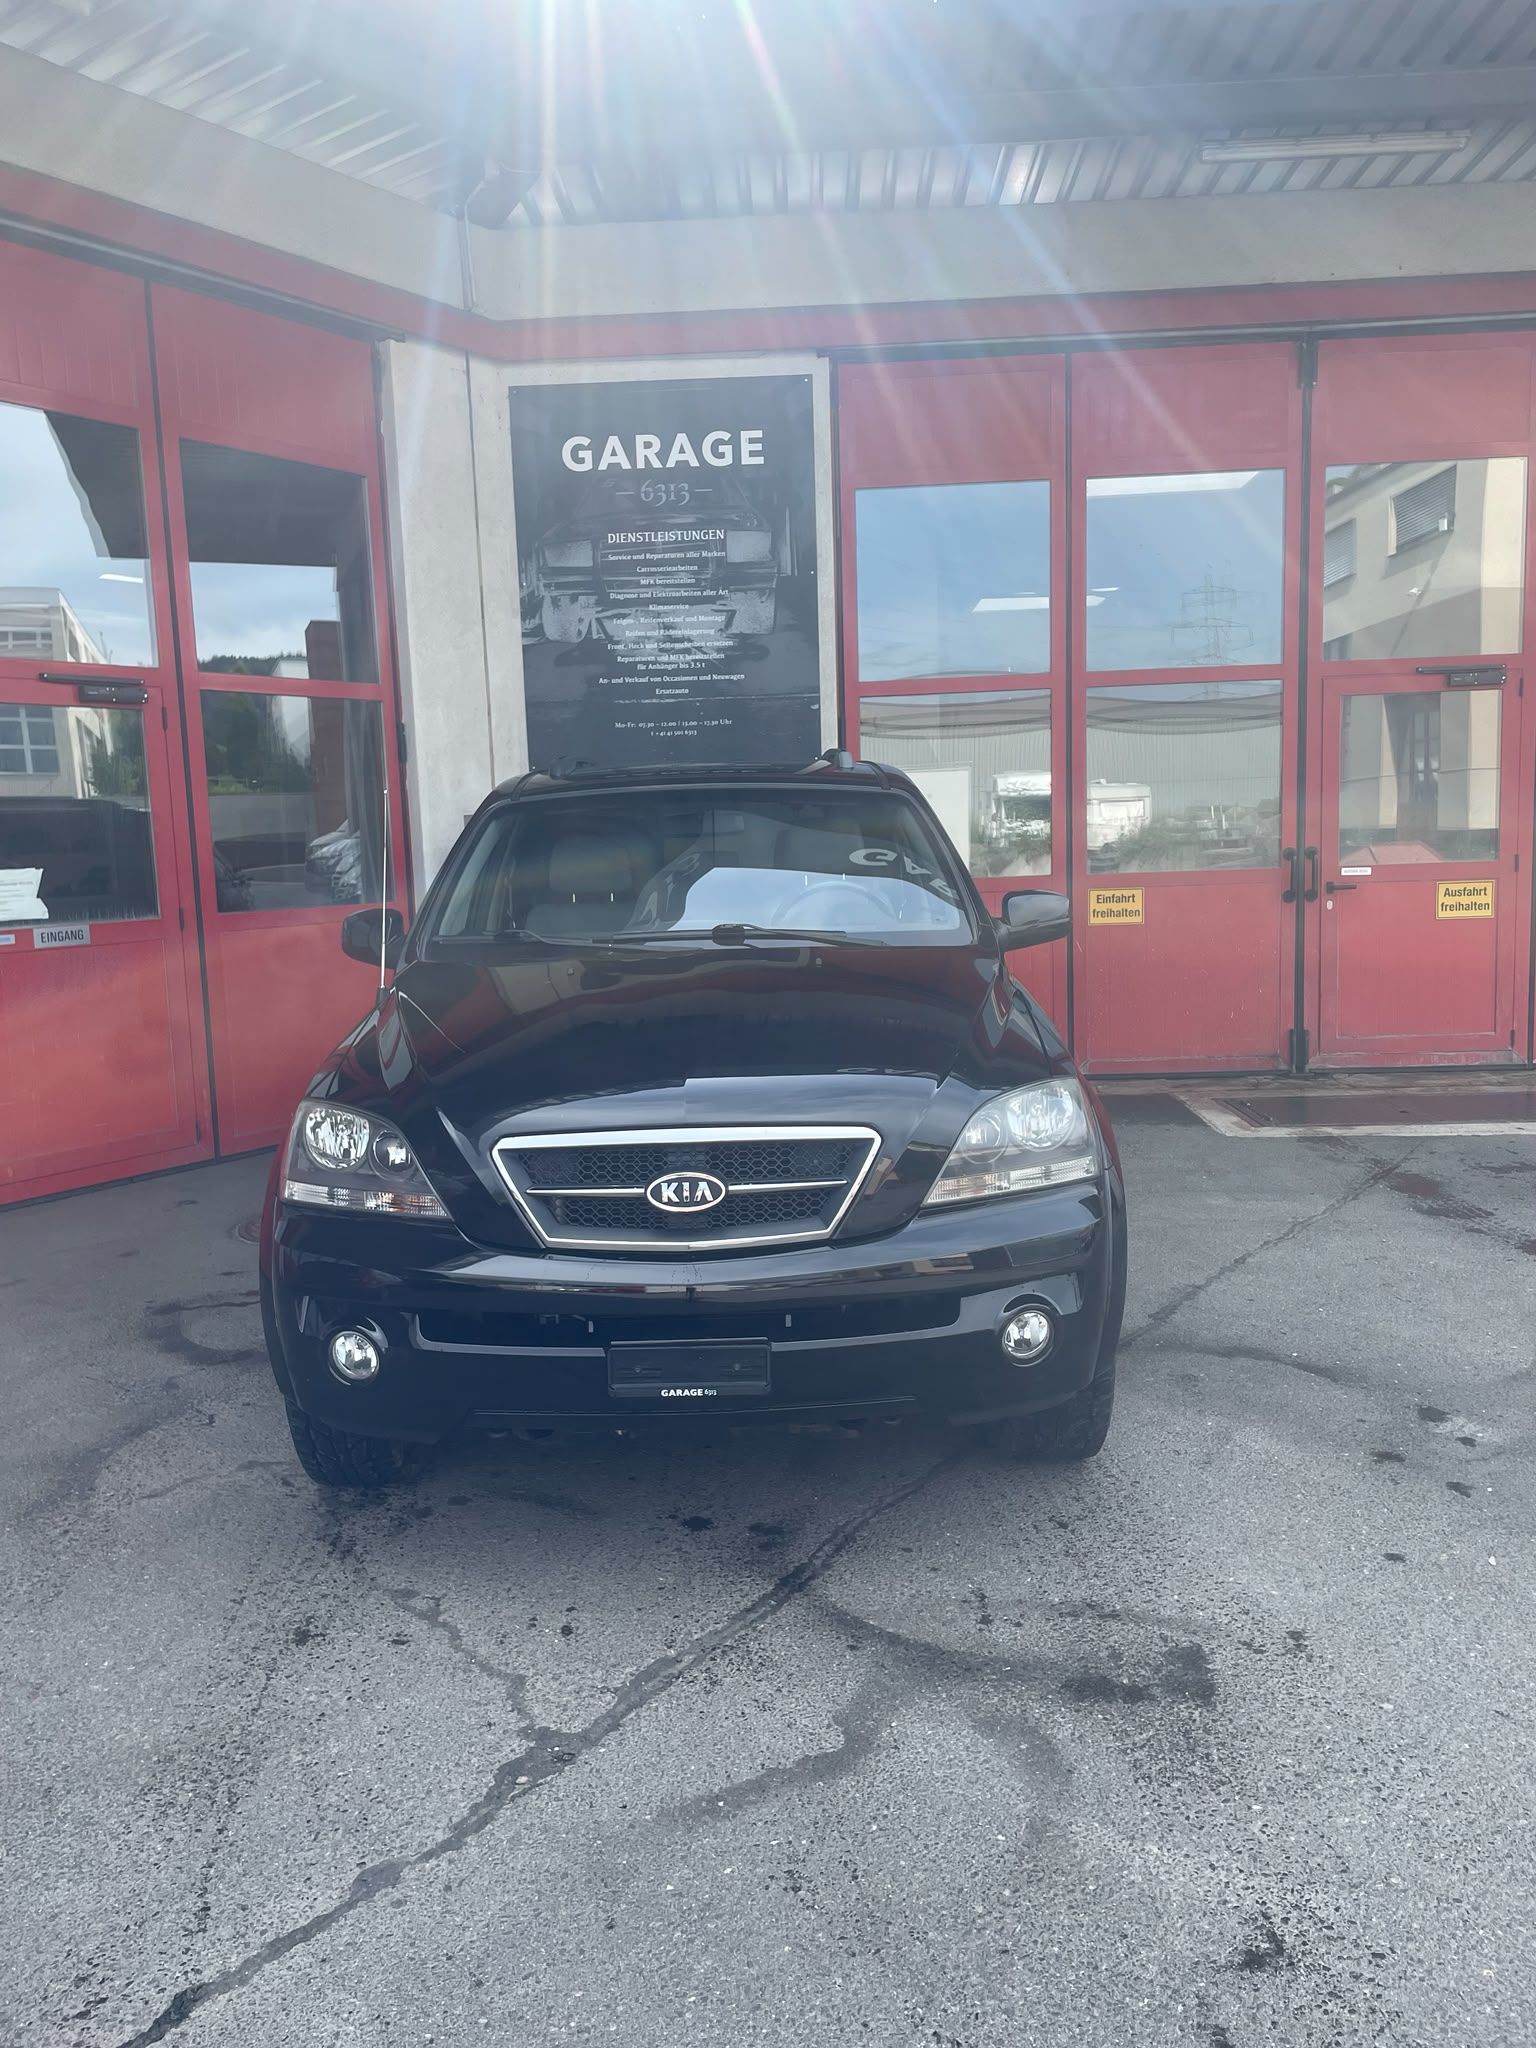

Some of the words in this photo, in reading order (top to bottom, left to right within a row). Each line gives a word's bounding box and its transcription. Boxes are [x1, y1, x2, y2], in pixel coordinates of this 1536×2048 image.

[561, 429, 765, 472] GARAGE
[640, 478, 691, 507] 6313
[607, 529, 725, 544] DIENSTLEISTUNGEN
[646, 552, 685, 561] Reparaturen
[686, 551, 700, 559] aller
[640, 578, 655, 586] MFK
[656, 577, 696, 585] bereitstellen
[610, 592, 638, 601] Diagnose
[639, 591, 652, 599] und
[653, 590, 701, 599] Elektroarbeiten
[702, 589, 717, 597] aller
[718, 588, 729, 597] Art
[640, 616, 684, 625] Reifenverkauf
[685, 615, 698, 623] und
[699, 614, 726, 623] Montage
[625, 630, 646, 638] Reifen
[646, 629, 659, 637] und
[645, 641, 658, 649] und
[706, 640, 734, 648] ersetzen
[617, 654, 656, 664] Reparaturen
[656, 654, 669, 662] und
[637, 663, 647, 671] für
[648, 662, 678, 672] Anhänger
[679, 661, 689, 670] bis
[690, 661, 701, 670] 3.5
[598, 677, 610, 685] An-
[611, 676, 624, 684] und
[624, 675, 649, 684] Verkauf
[662, 674, 698, 683] Occasionen
[699, 673, 711, 682] und
[712, 673, 745, 681] Neuwagen
[655, 687, 690, 696] Ersatzauto
[614, 721, 636, 729] Mo-Fr:
[719, 718, 733, 726] Uhr
[1442, 885, 1489, 899] Ausfahrt
[1095, 891, 1137, 906] Einfahrt
[1091, 904, 1142, 920] freihalten
[1439, 898, 1491, 914] freihalten
[40, 929, 85, 944] EINGANG
[660, 1181, 714, 1203] KIA
[661, 1388, 704, 1397] GARAGE
